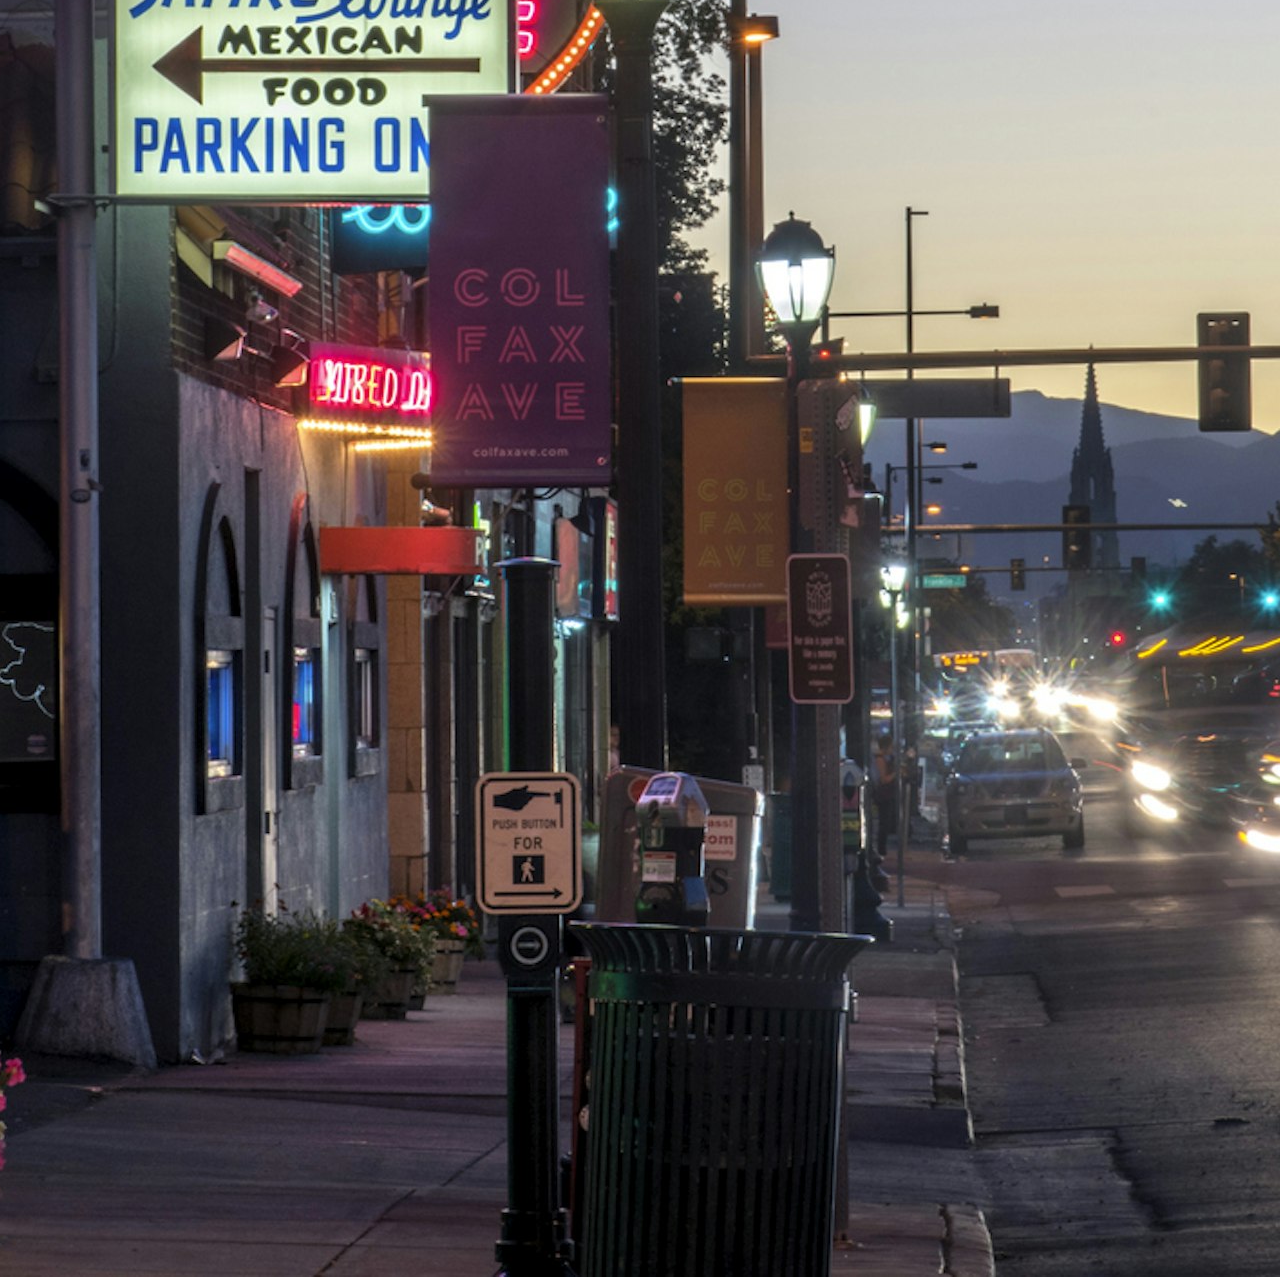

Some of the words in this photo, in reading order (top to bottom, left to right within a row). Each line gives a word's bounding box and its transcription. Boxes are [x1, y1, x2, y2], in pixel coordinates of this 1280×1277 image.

[218, 24, 424, 55] MEXICAN
[263, 78, 388, 107] FOOD
[134, 117, 345, 174] PARKING
[454, 268, 585, 307] COL
[456, 325, 585, 364] FAX
[455, 382, 585, 421] AVE
[472, 445, 569, 459] colfaxave.com
[697, 478, 772, 502] COL
[699, 511, 773, 535] FAX
[697, 544, 774, 568] AVE
[493, 818, 518, 830] PUSH
[521, 818, 557, 830] BUTTON
[513, 836, 543, 850] FOR
